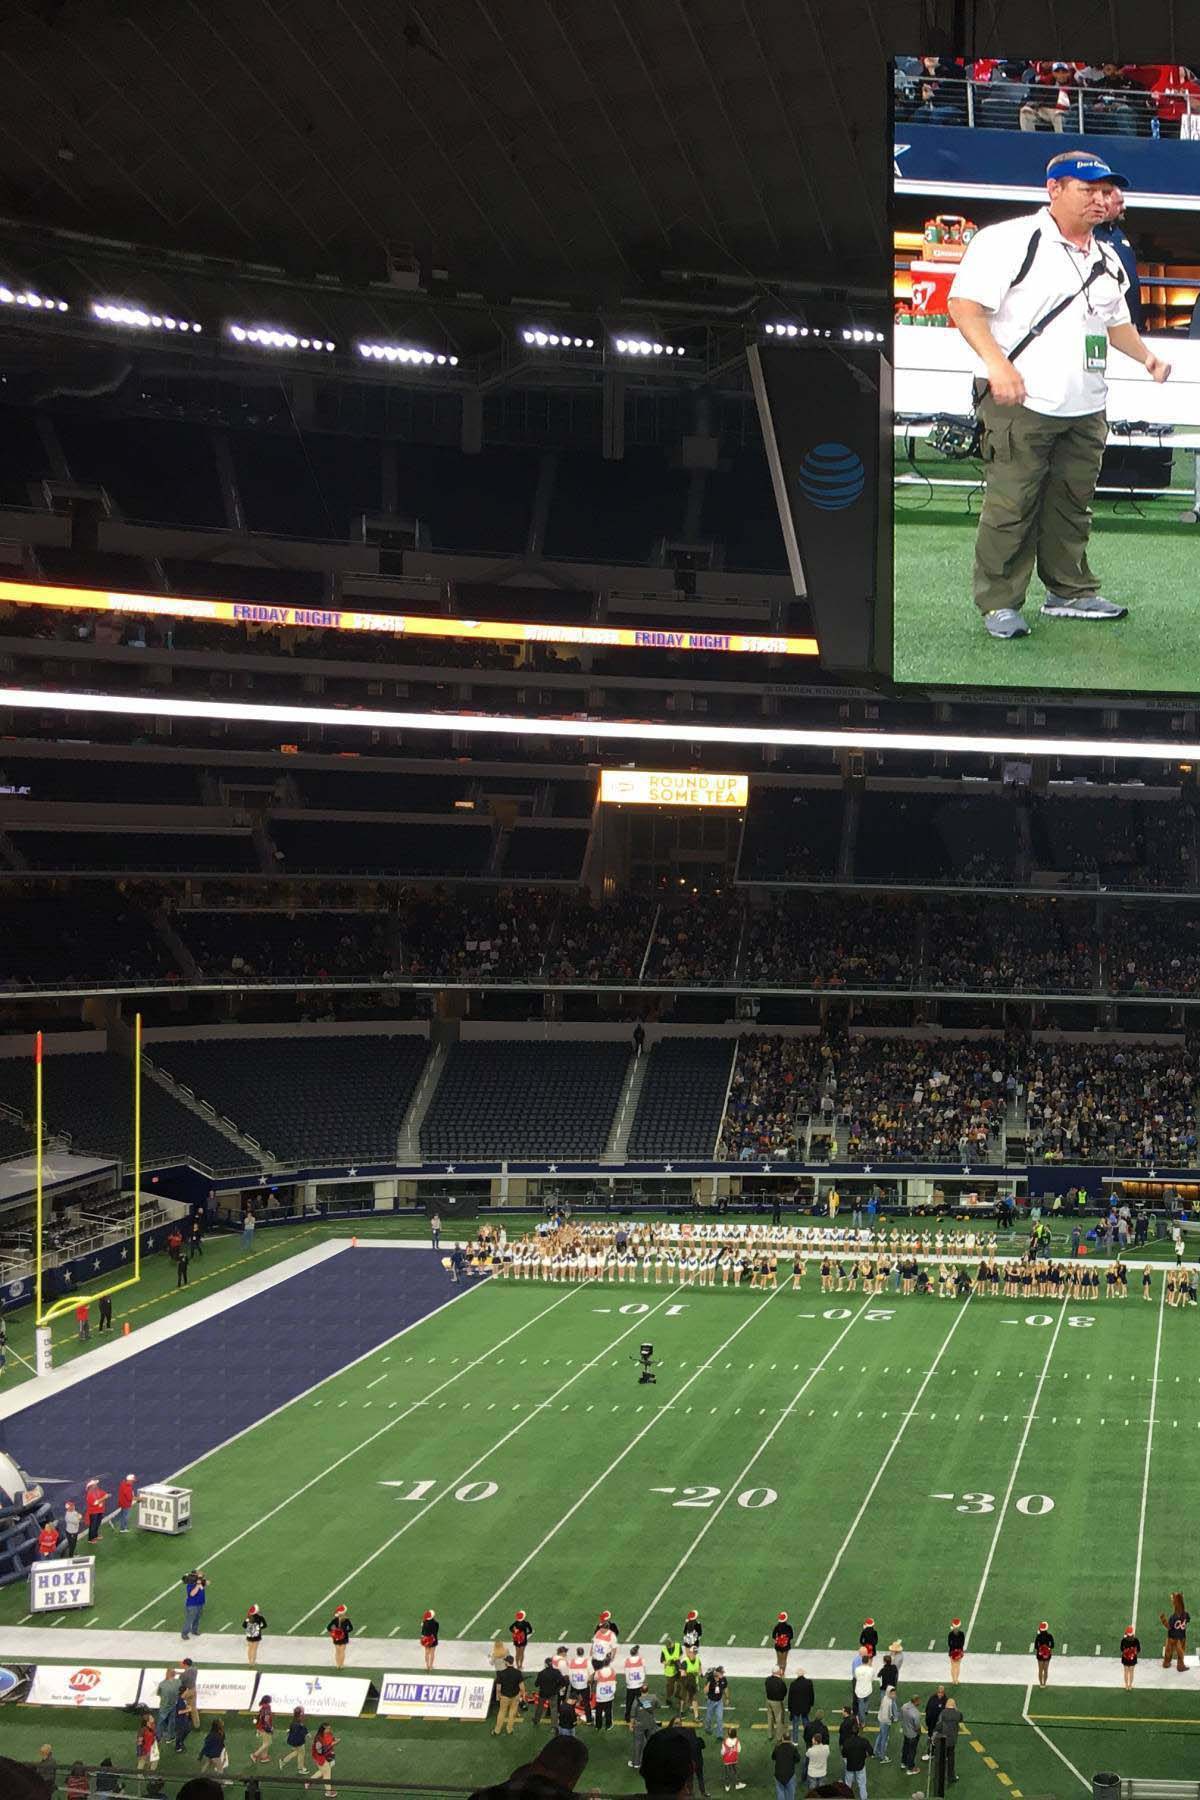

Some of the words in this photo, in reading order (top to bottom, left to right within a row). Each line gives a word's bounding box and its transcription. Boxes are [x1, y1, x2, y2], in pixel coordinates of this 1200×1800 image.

[233, 604, 289, 622] FRIDAY
[294, 608, 343, 626] NIGHT
[635, 631, 684, 648] FRIDAY
[689, 634, 732, 650] NIGHT
[650, 776, 708, 789] ROUND
[716, 779, 737, 790] UP
[650, 789, 699, 801] SOME
[707, 791, 736, 803] TEA
[395, 1480, 499, 1502] 10
[671, 1486, 778, 1508] 20
[141, 1496, 171, 1513] HOKA
[954, 1492, 1055, 1515] 30
[145, 1513, 168, 1528] HEY
[38, 1570, 87, 1589] HOKA
[44, 1589, 81, 1605] HEY
[385, 1684, 417, 1700] MAIN
[420, 1685, 459, 1702] EVENT
